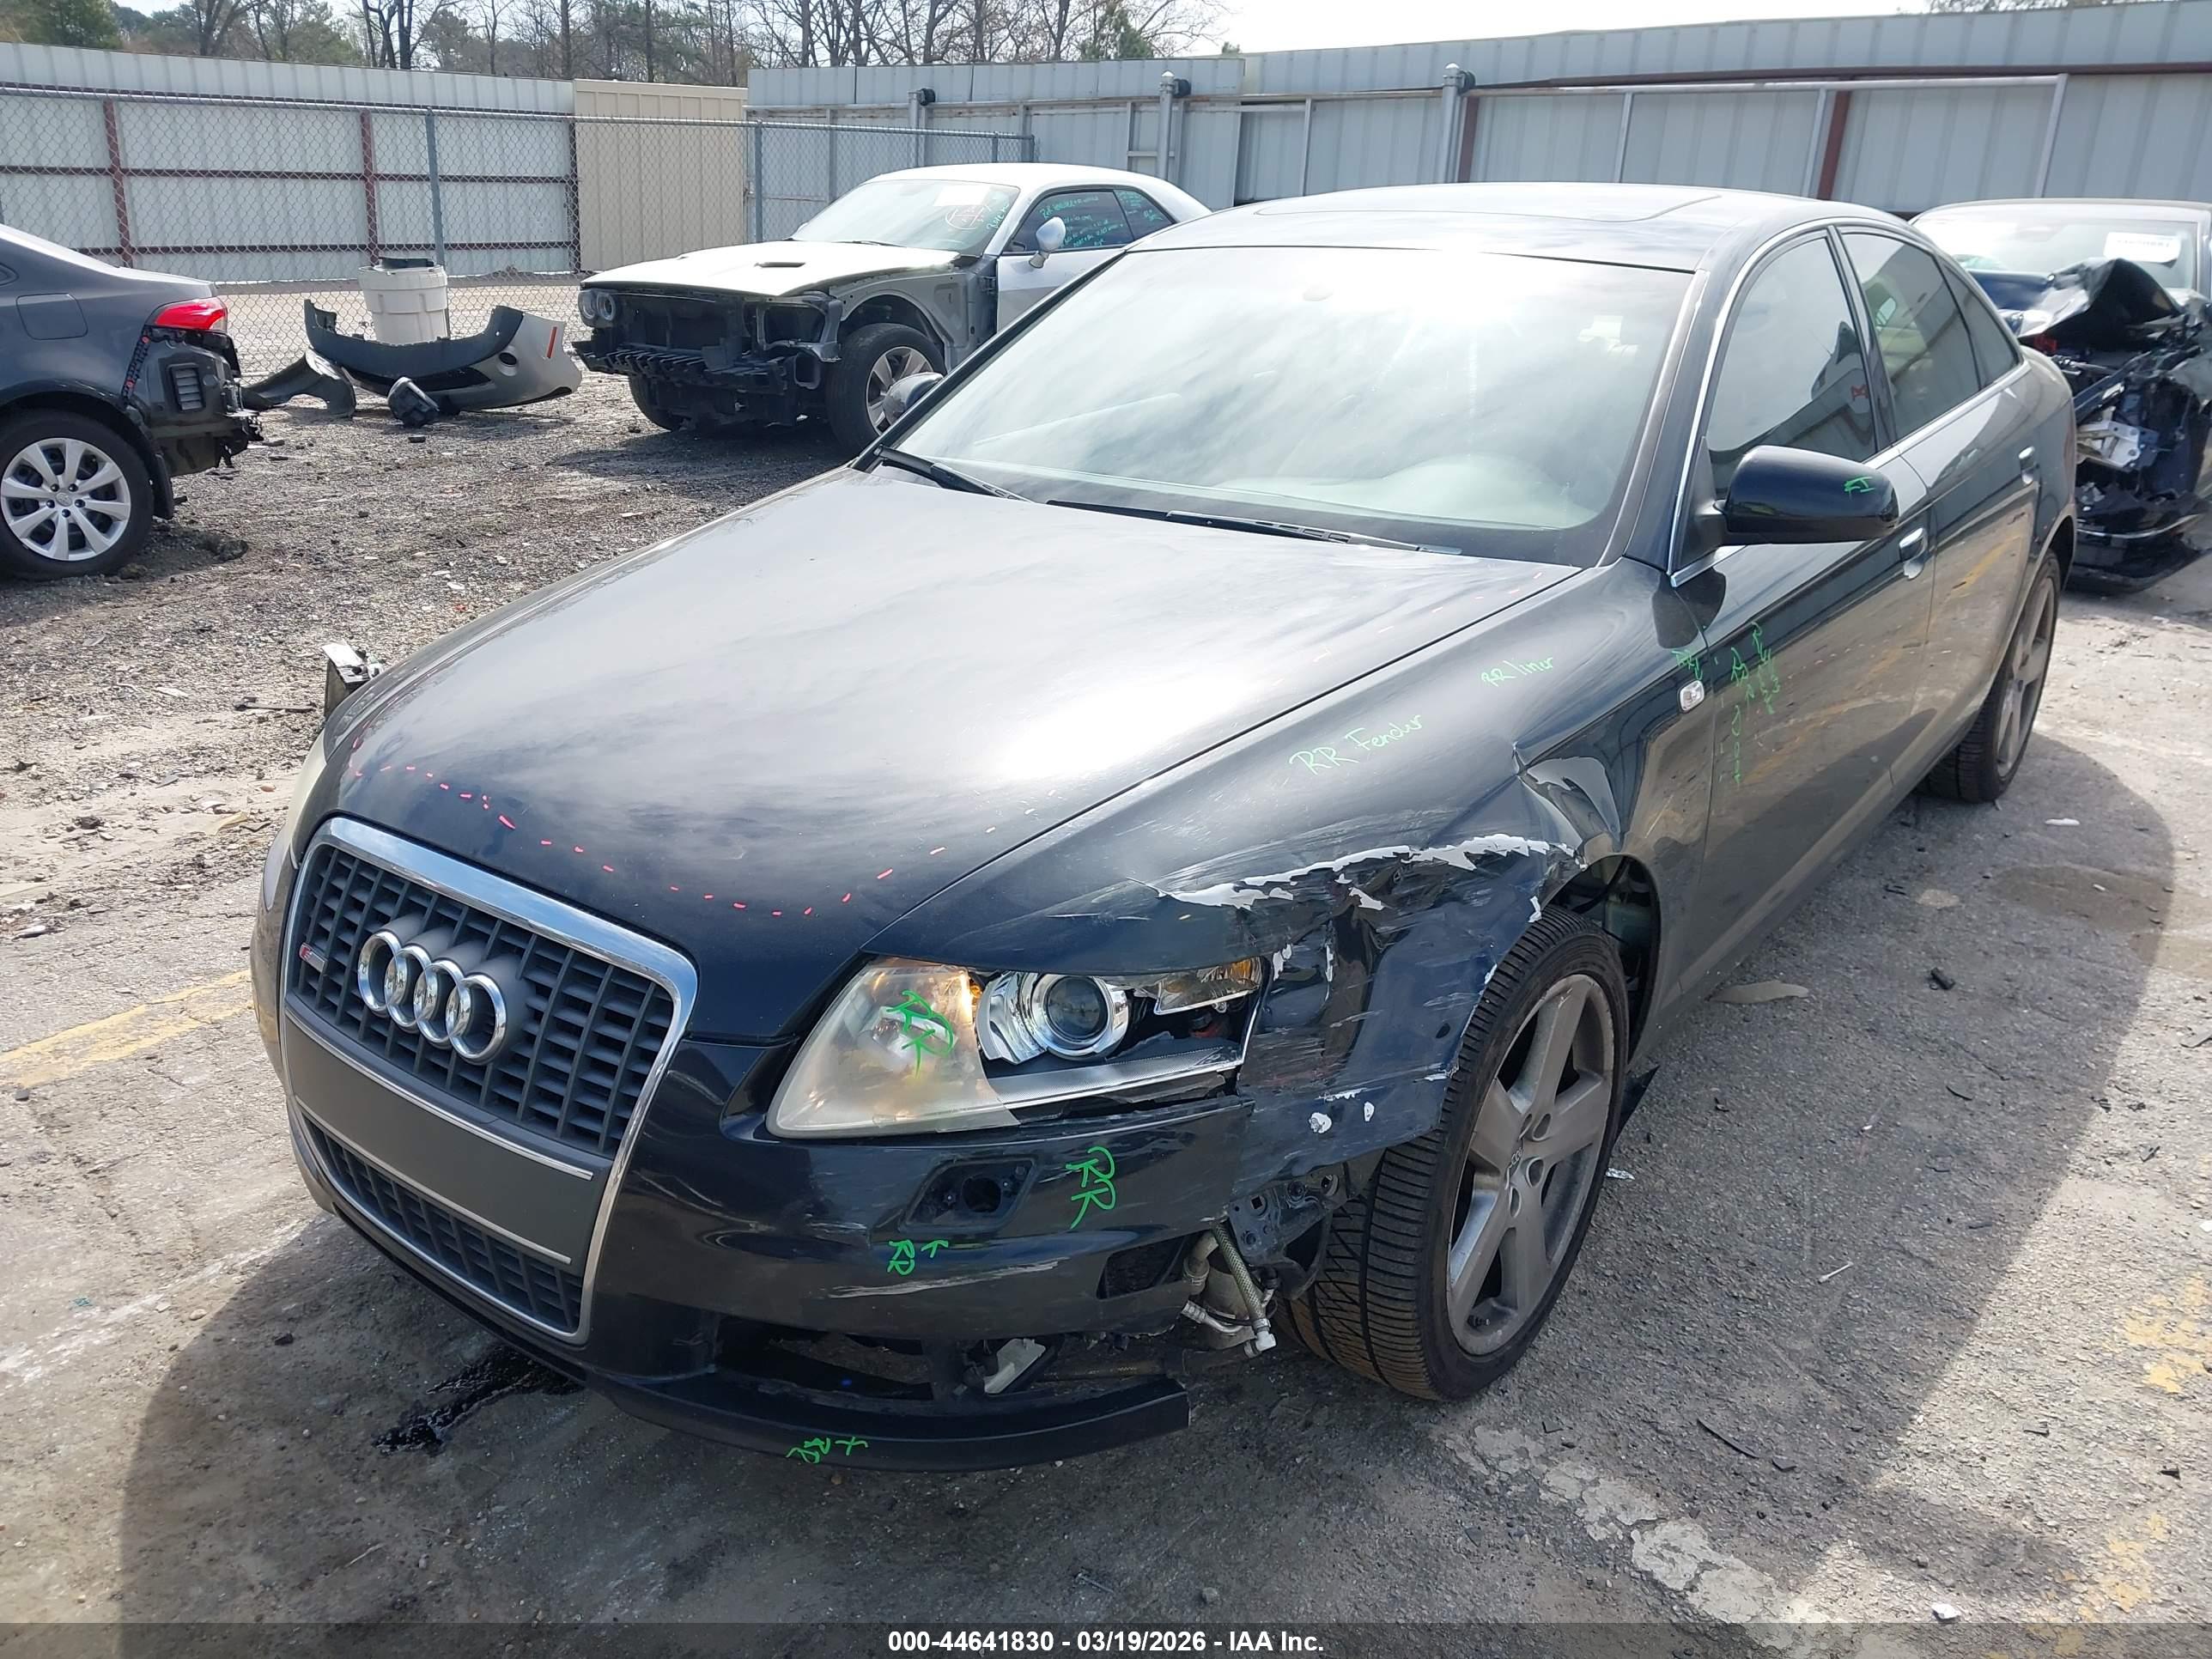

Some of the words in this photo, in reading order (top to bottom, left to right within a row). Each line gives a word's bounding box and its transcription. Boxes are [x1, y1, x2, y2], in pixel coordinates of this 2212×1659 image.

[1480, 667, 1516, 688] RR
[1288, 746, 1359, 775] RR
[1064, 1145, 1117, 1229] RR
